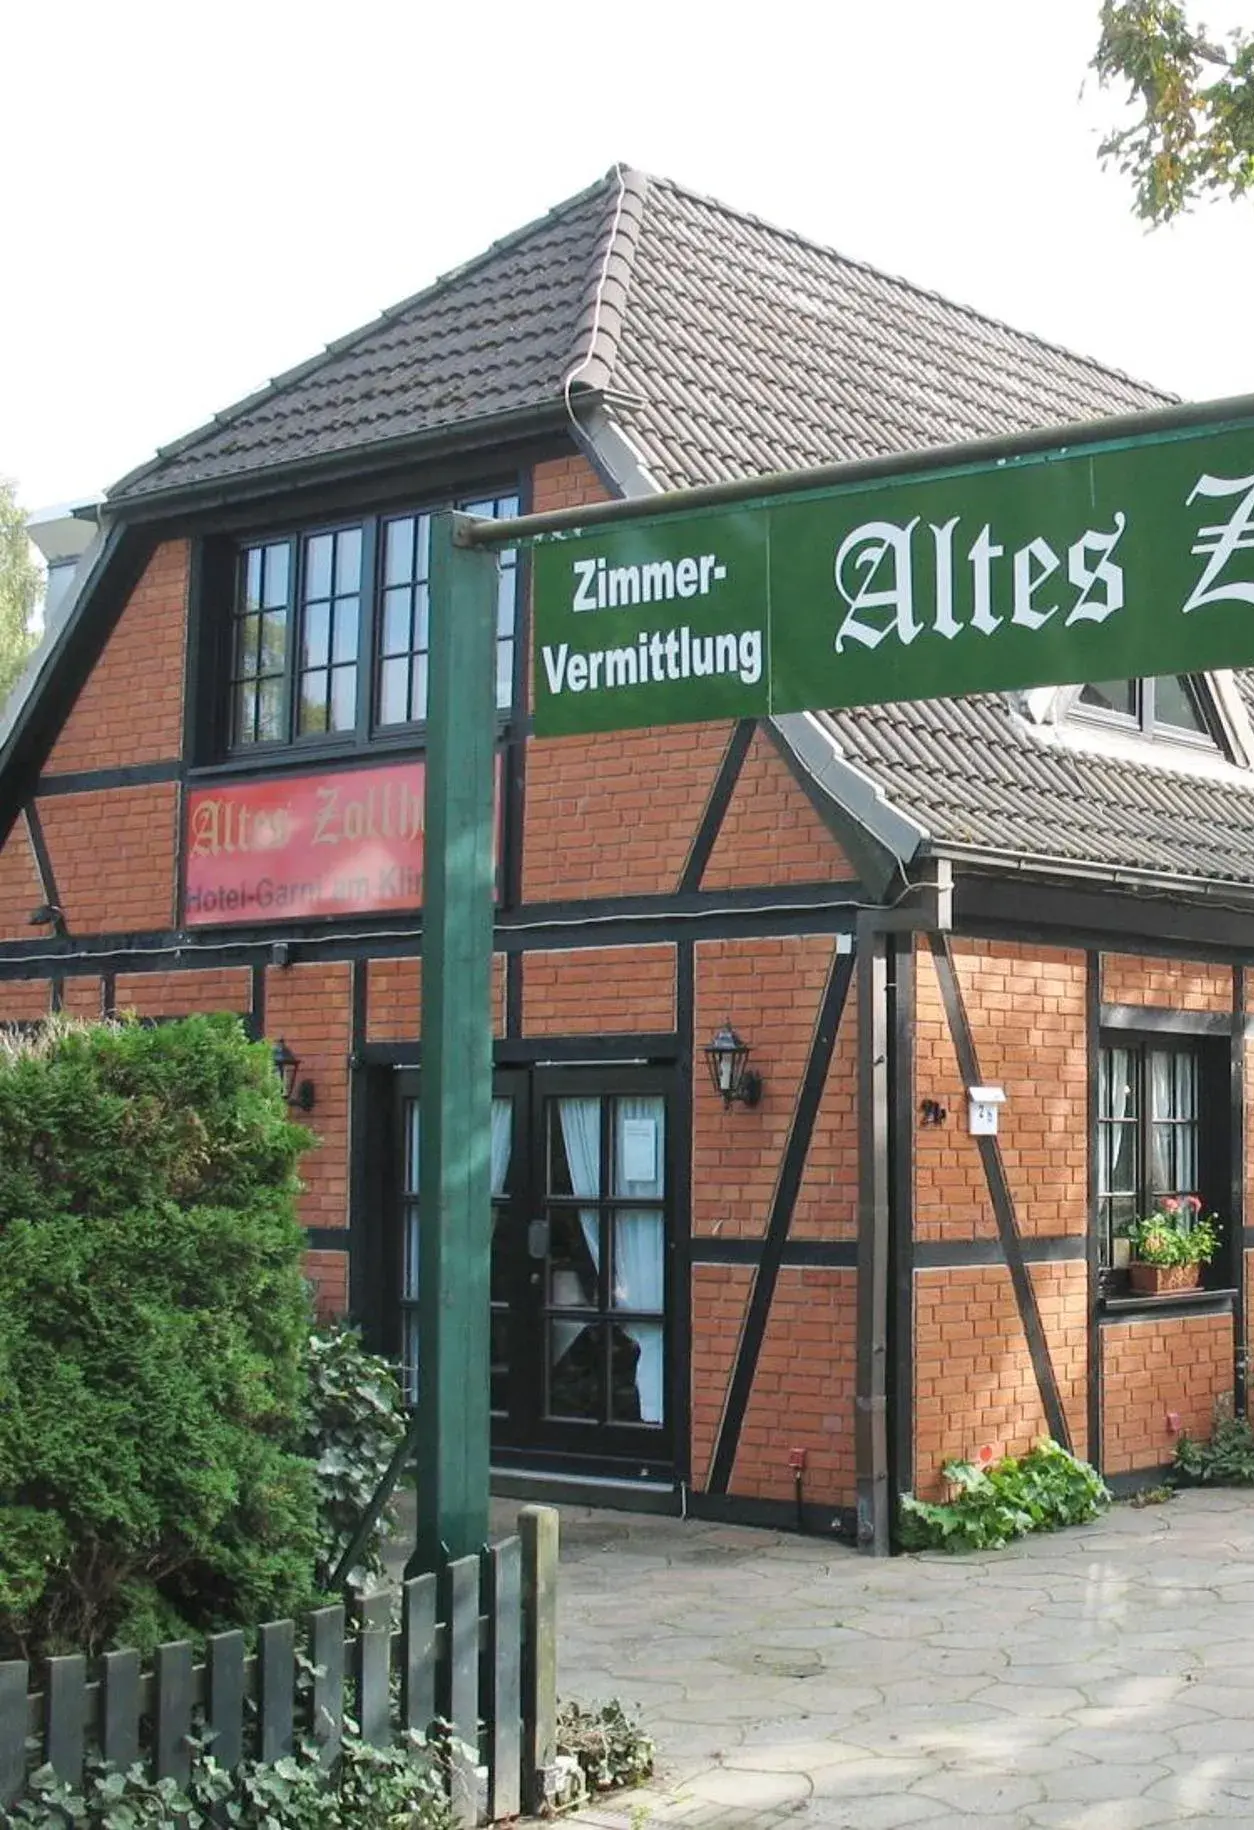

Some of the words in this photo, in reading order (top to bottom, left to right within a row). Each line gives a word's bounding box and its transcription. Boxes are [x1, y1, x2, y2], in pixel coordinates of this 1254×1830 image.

[572, 553, 727, 613] Zimmer-
[834, 511, 1125, 653] Altes
[541, 626, 762, 695] Vermittlung
[190, 798, 292, 858] Altes
[311, 780, 425, 848] Zollh
